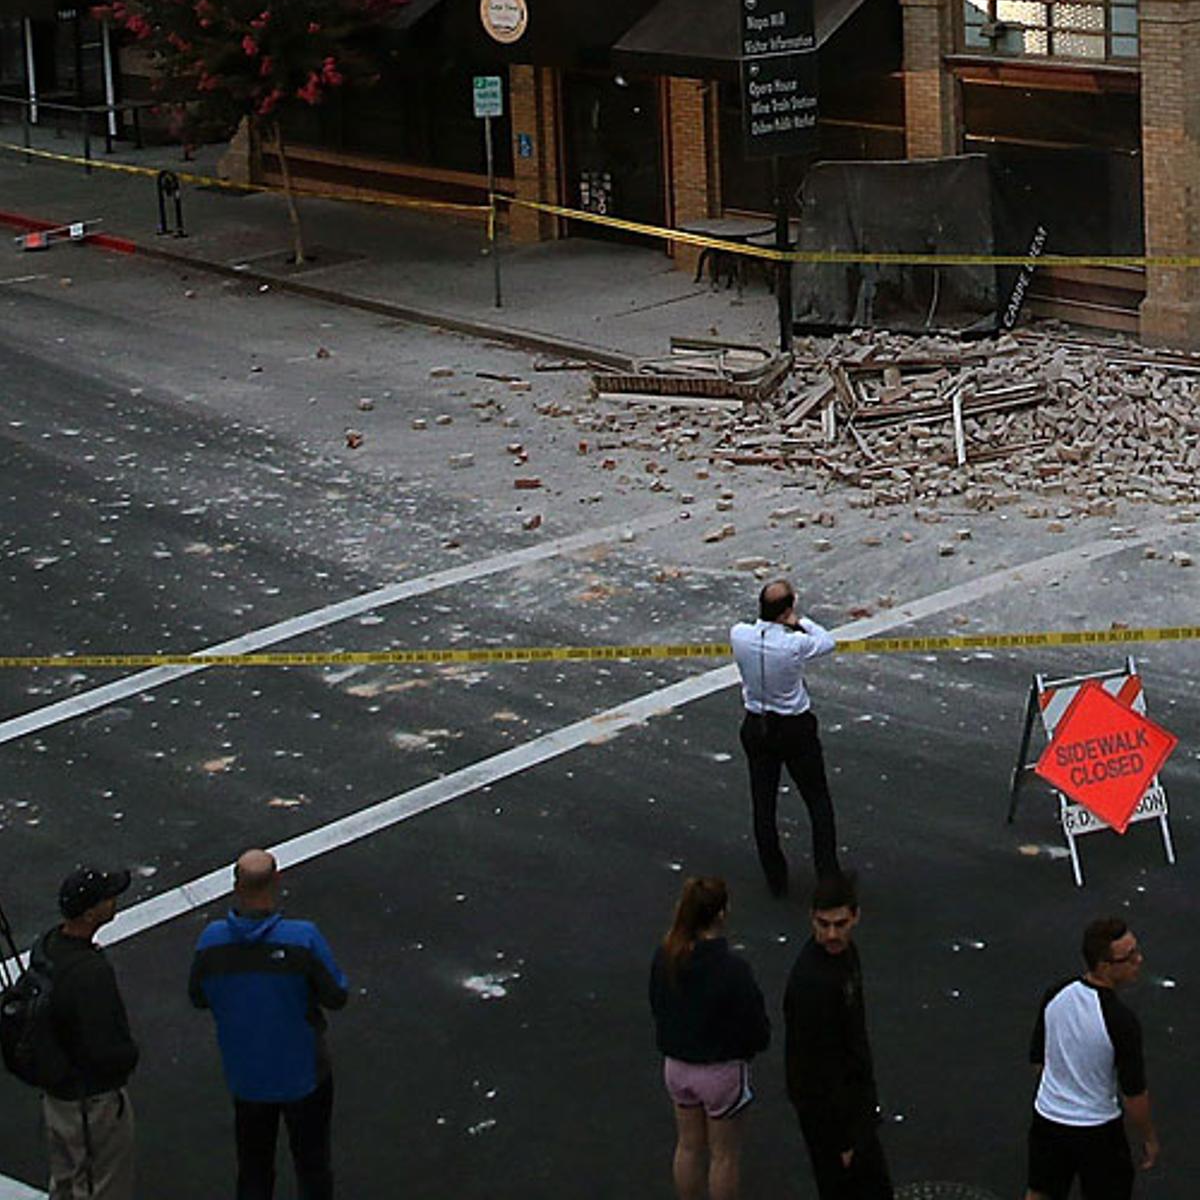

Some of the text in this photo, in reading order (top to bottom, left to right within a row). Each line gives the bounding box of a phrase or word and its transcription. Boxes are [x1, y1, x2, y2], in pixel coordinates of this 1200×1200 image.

[749, 80, 797, 99] Opera House
[1055, 728, 1149, 767] SIDEWALK
[1070, 753, 1145, 787] CLOSED
